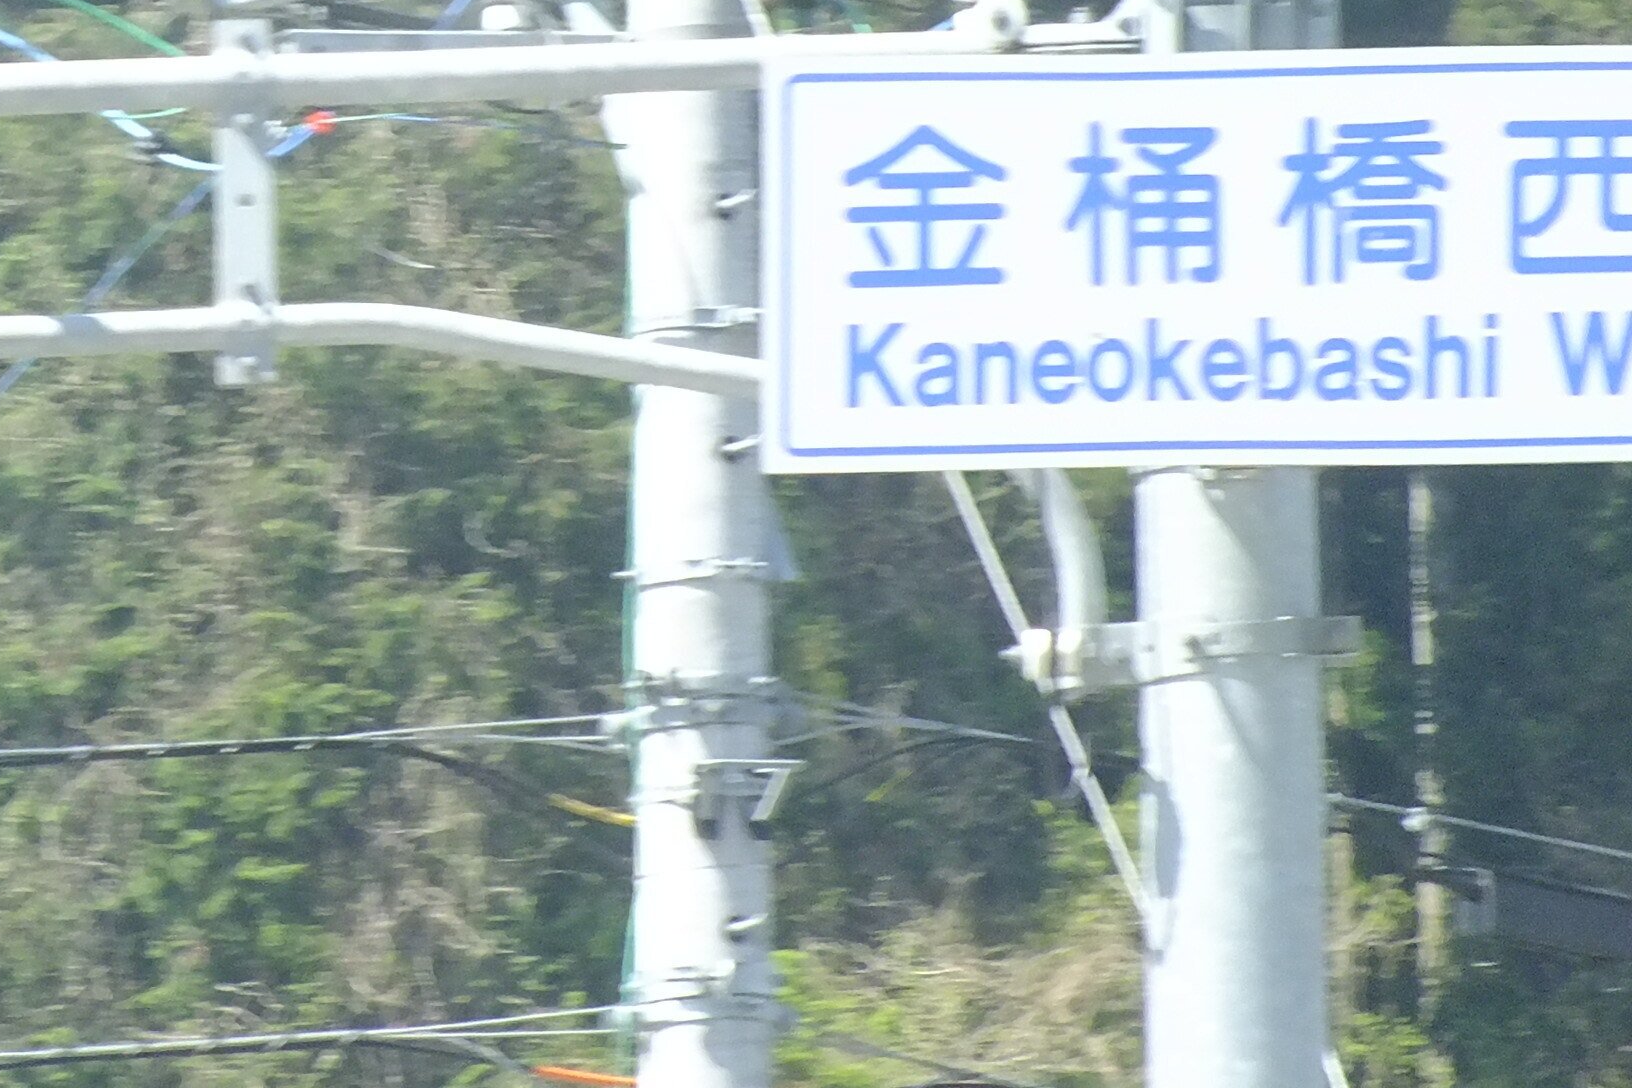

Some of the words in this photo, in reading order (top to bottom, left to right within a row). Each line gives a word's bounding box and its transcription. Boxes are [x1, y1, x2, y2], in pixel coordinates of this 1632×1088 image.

[843, 117, 1632, 287] 金桶橋西
[846, 314, 1498, 407] Kaneokebashi
